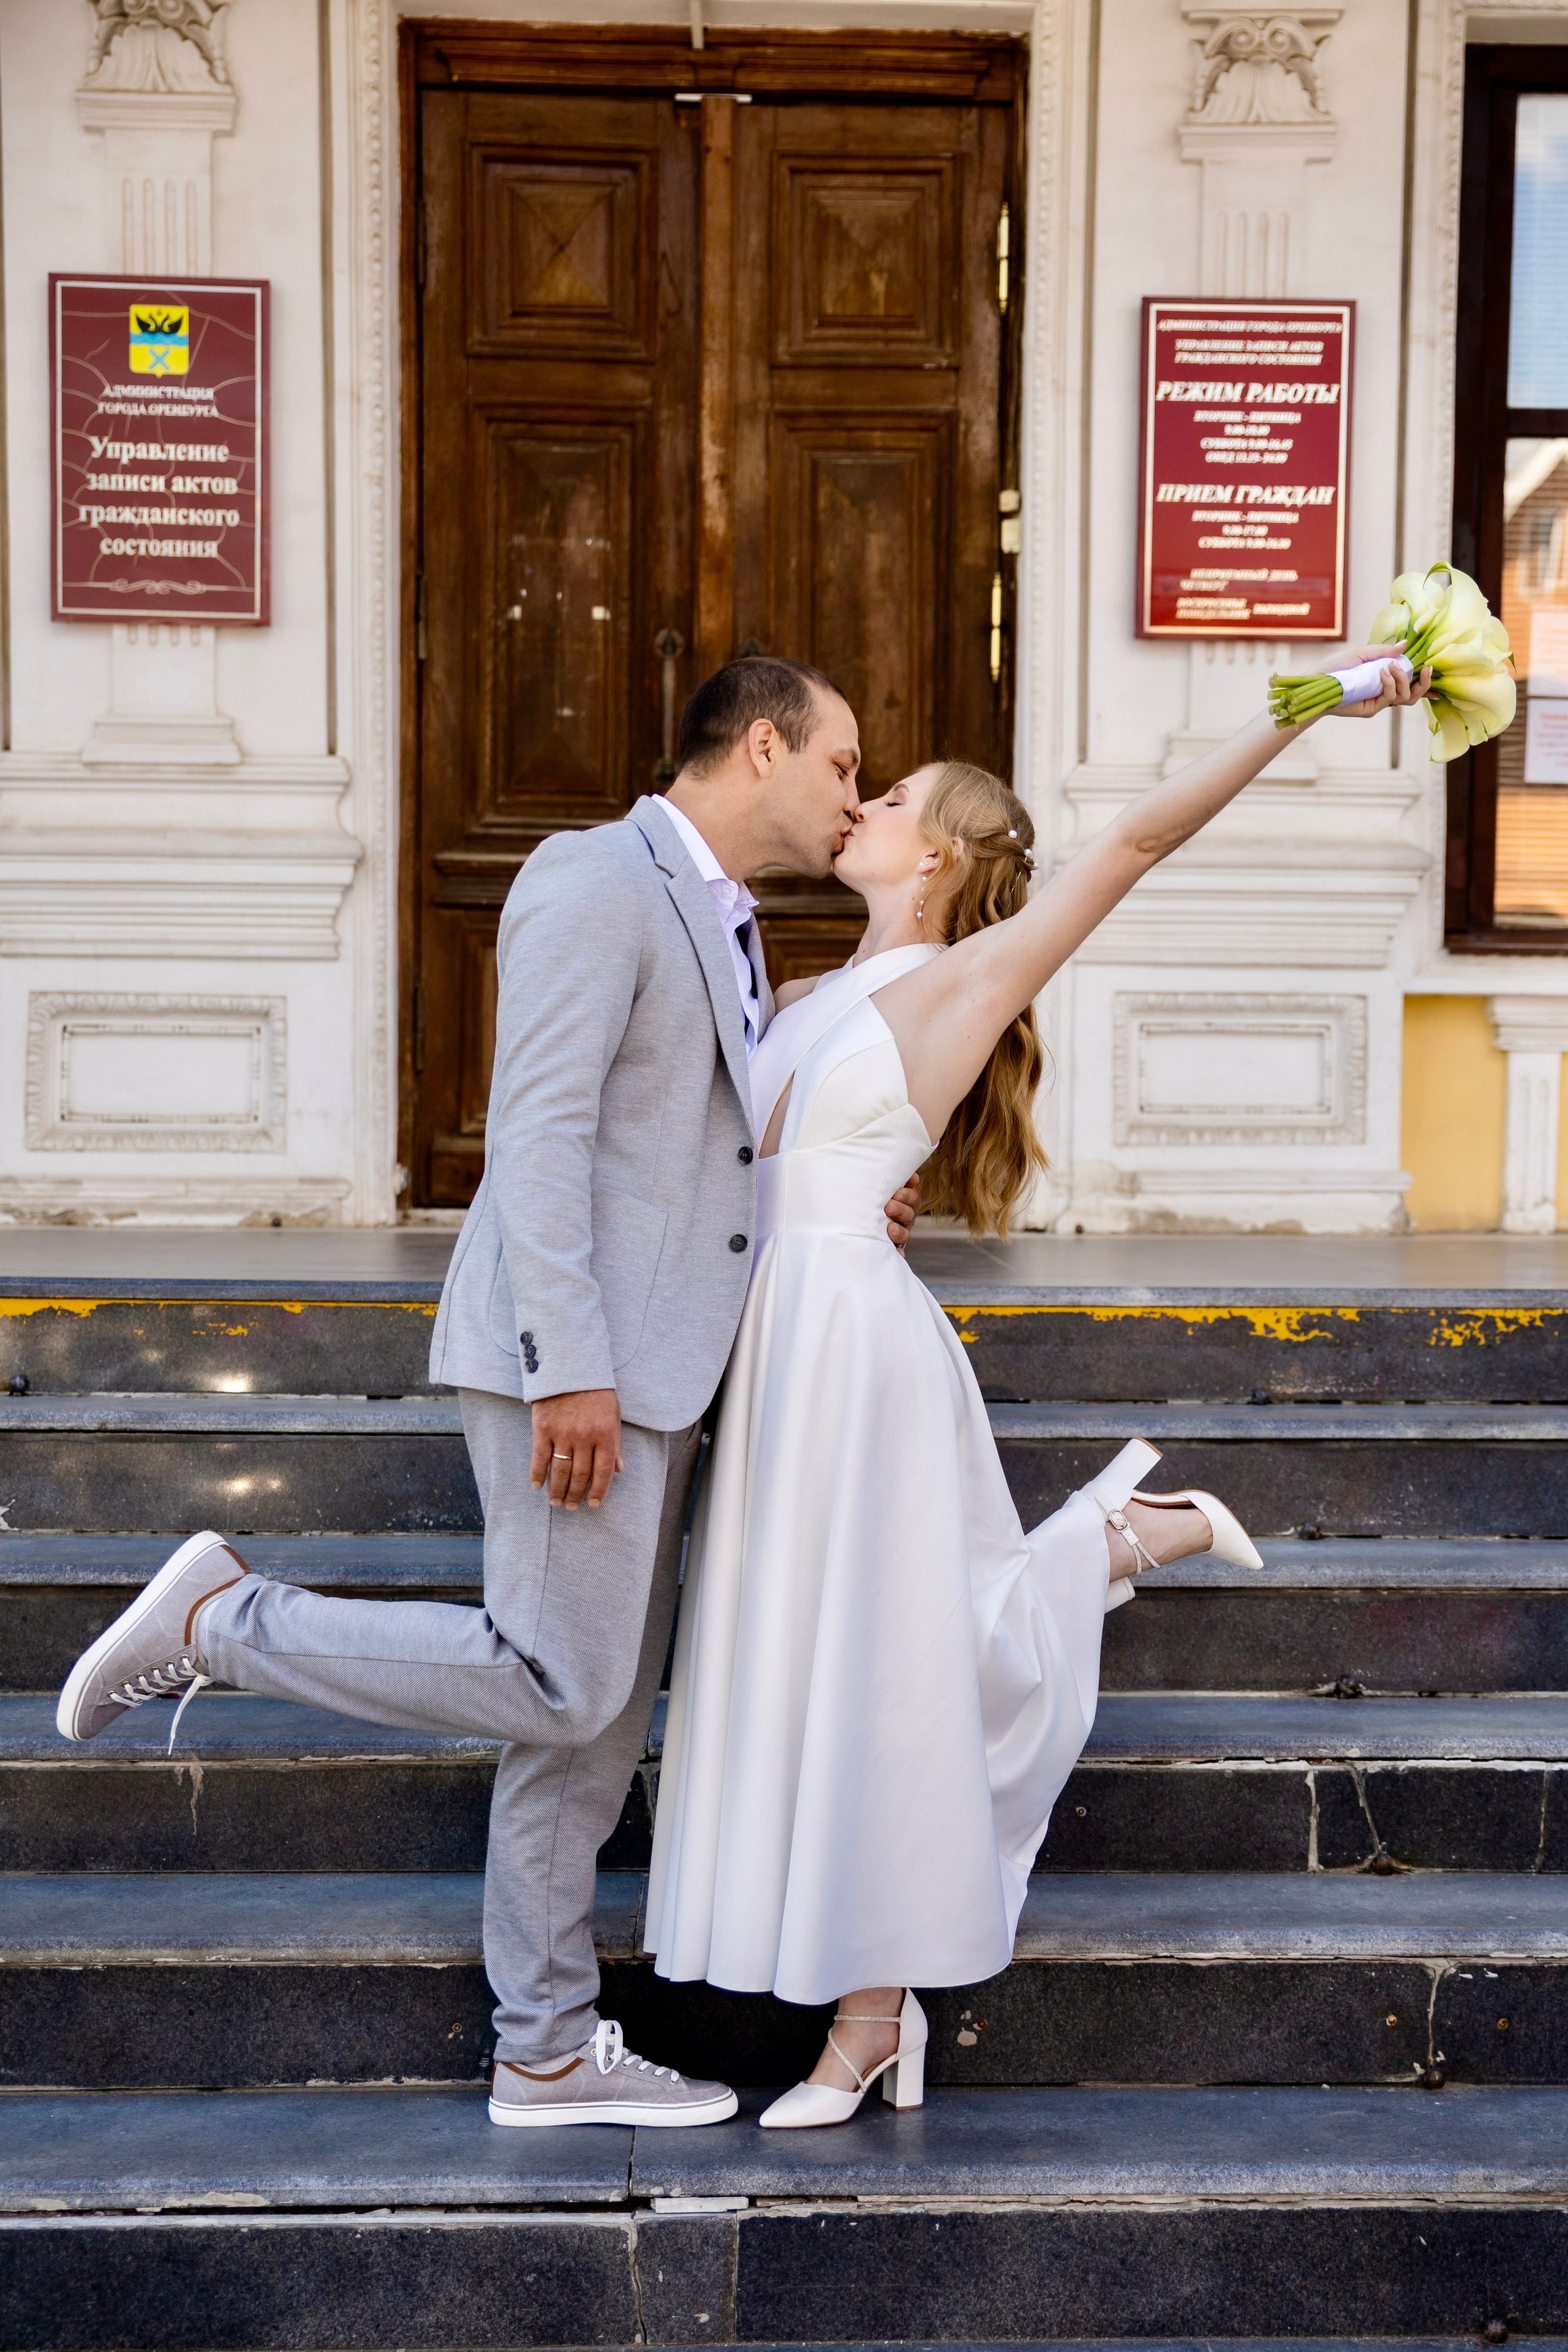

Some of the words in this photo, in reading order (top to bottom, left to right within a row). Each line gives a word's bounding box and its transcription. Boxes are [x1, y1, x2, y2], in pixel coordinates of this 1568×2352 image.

[1156, 381, 1246, 402] РЕЖИМ
[1245, 382, 1340, 404] РАБОТЫ
[90, 436, 229, 465] Управление
[86, 473, 165, 492] записи
[171, 475, 238, 495] актов
[1156, 483, 1235, 503] ПРИЕМ
[1234, 484, 1336, 508] ГРАЖДАН
[79, 505, 239, 528] гражданского
[100, 538, 218, 558] состояния
